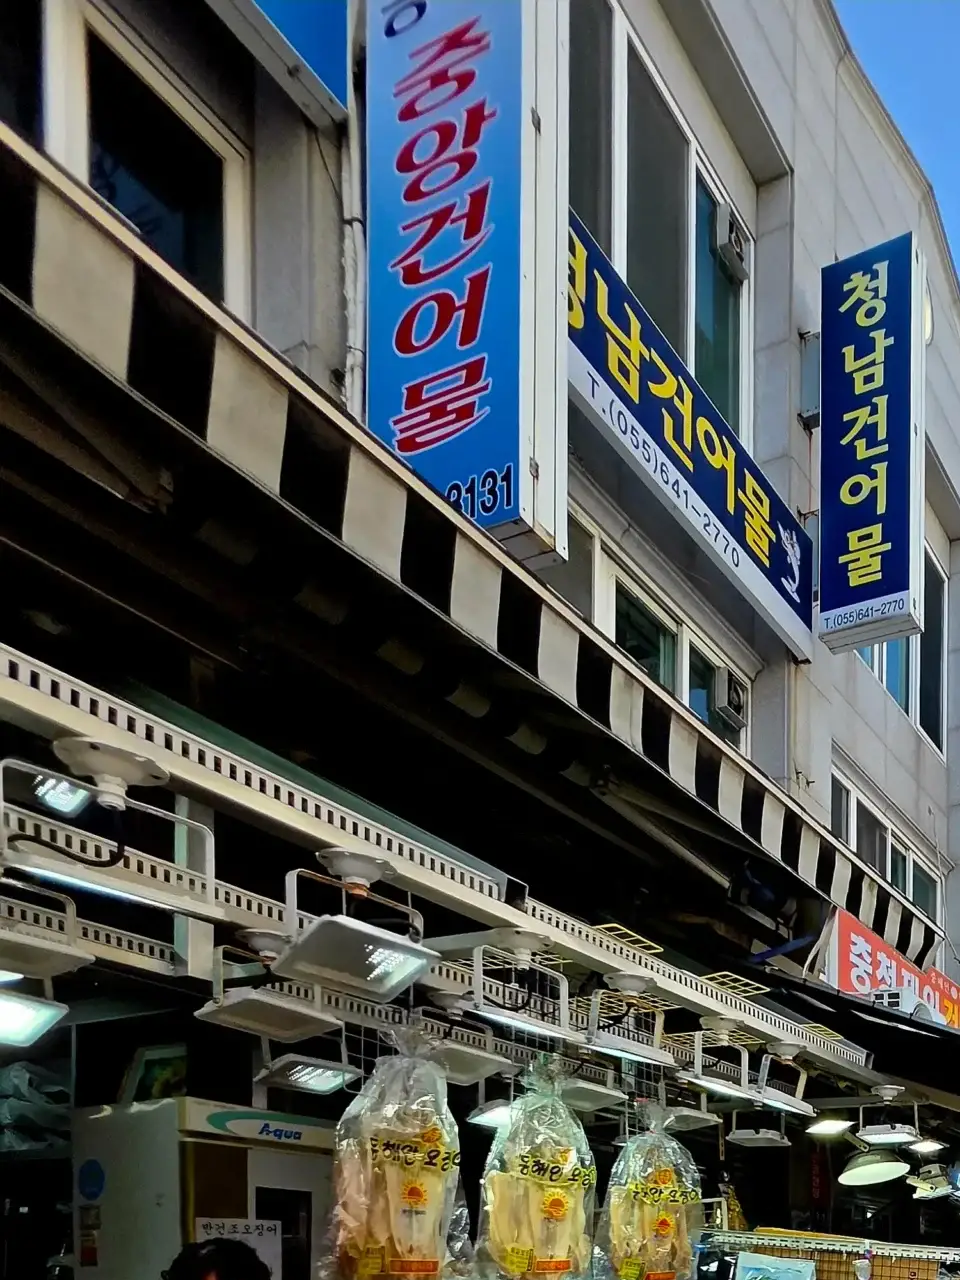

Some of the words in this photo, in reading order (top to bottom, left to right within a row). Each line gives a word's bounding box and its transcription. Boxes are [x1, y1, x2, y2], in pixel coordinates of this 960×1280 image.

[388, 16, 497, 457] 중앙건어물
[839, 259, 896, 588] 청남건어물
[824, 597, 906, 630] T.(055)641-2770
[258, 1122, 302, 1140] Aqua
